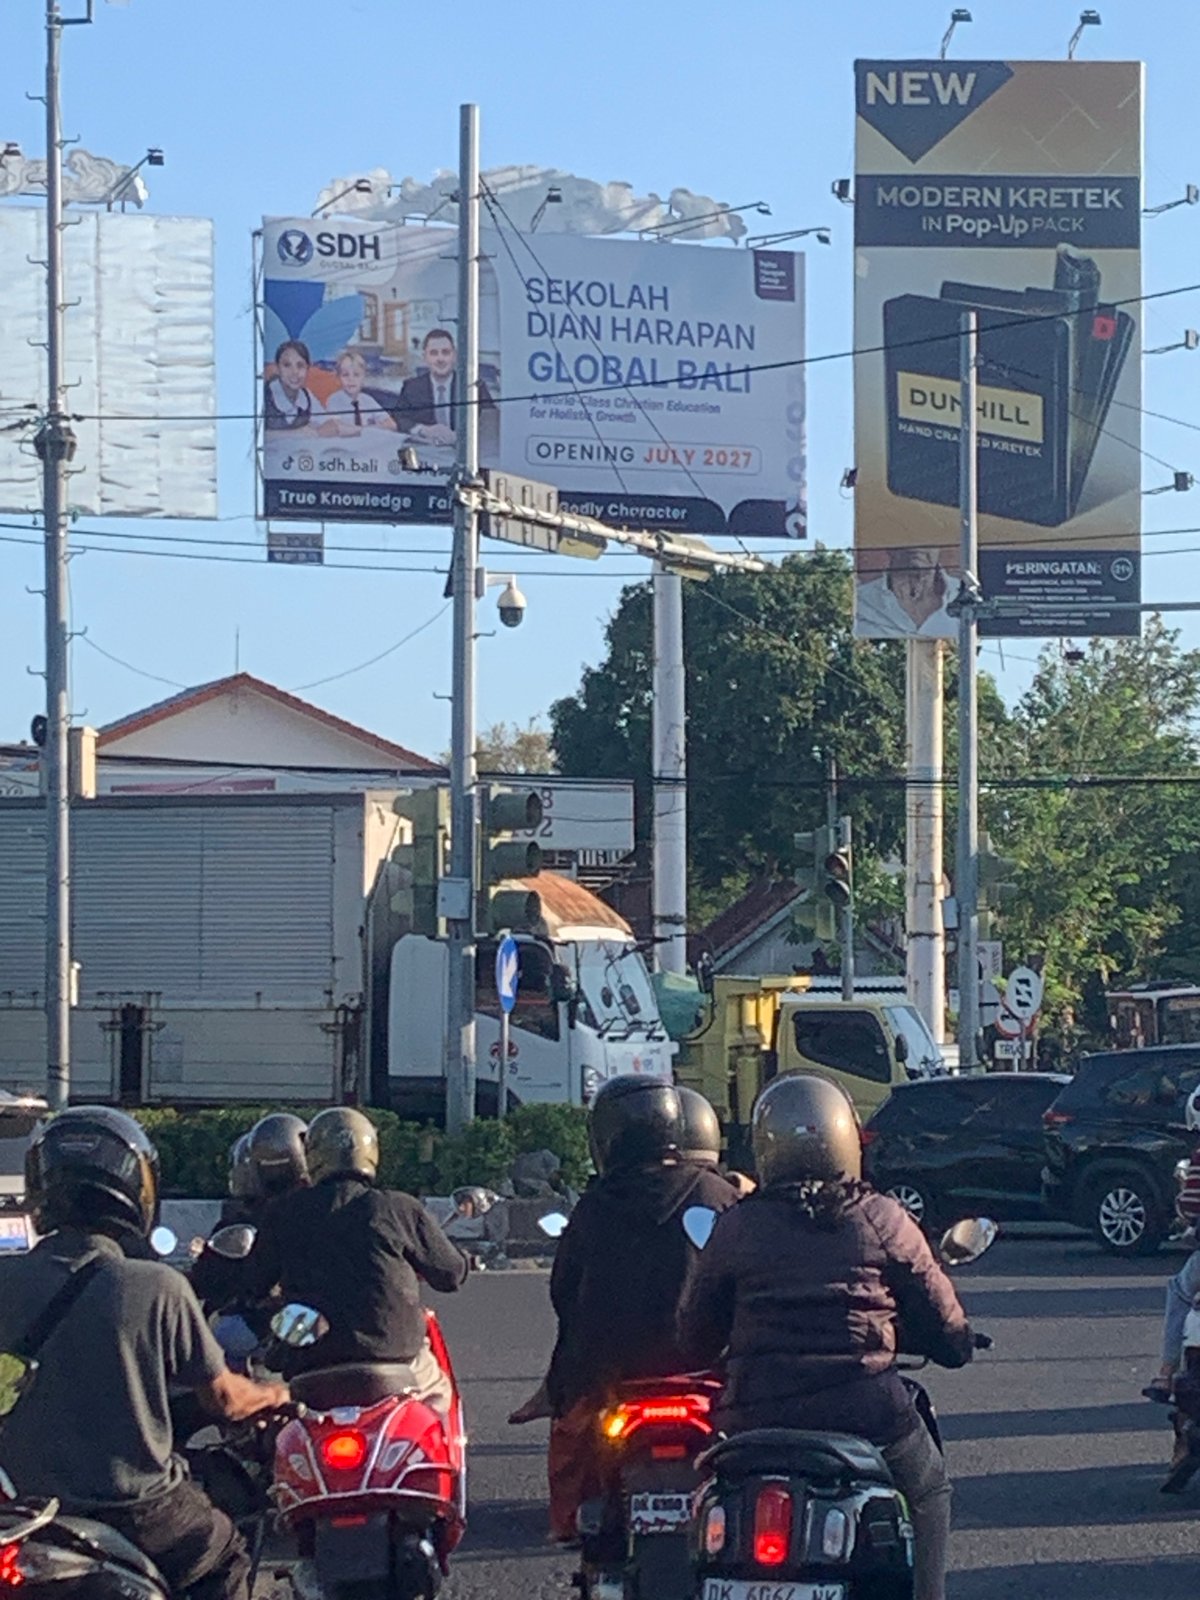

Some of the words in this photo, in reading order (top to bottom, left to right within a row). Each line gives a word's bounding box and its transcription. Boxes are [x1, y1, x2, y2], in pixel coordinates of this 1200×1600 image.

[865, 71, 976, 105] NEW
[877, 186, 1001, 208] MODERN
[1009, 187, 1123, 209] KRETEK
[922, 216, 943, 232] IN
[946, 213, 1029, 238] Pop-Up
[1032, 216, 1085, 233] PACK
[316, 232, 380, 260] SDH
[526, 277, 669, 311] SEKOLAH
[527, 311, 602, 342] DIAN
[611, 315, 755, 350] HARAPAN
[527, 351, 669, 389] GLOBAL
[677, 359, 751, 394] BALI
[529, 406, 547, 419] for
[667, 399, 721, 414] Education
[897, 423, 932, 438] HAND
[992, 440, 1043, 458] KRETEK
[536, 442, 635, 463] OPENING
[643, 448, 696, 466] JULY
[703, 450, 753, 469] 2027
[279, 489, 317, 505] True
[320, 490, 412, 513] Knowledge
[428, 495, 453, 510] Fai
[607, 503, 688, 519] Character
